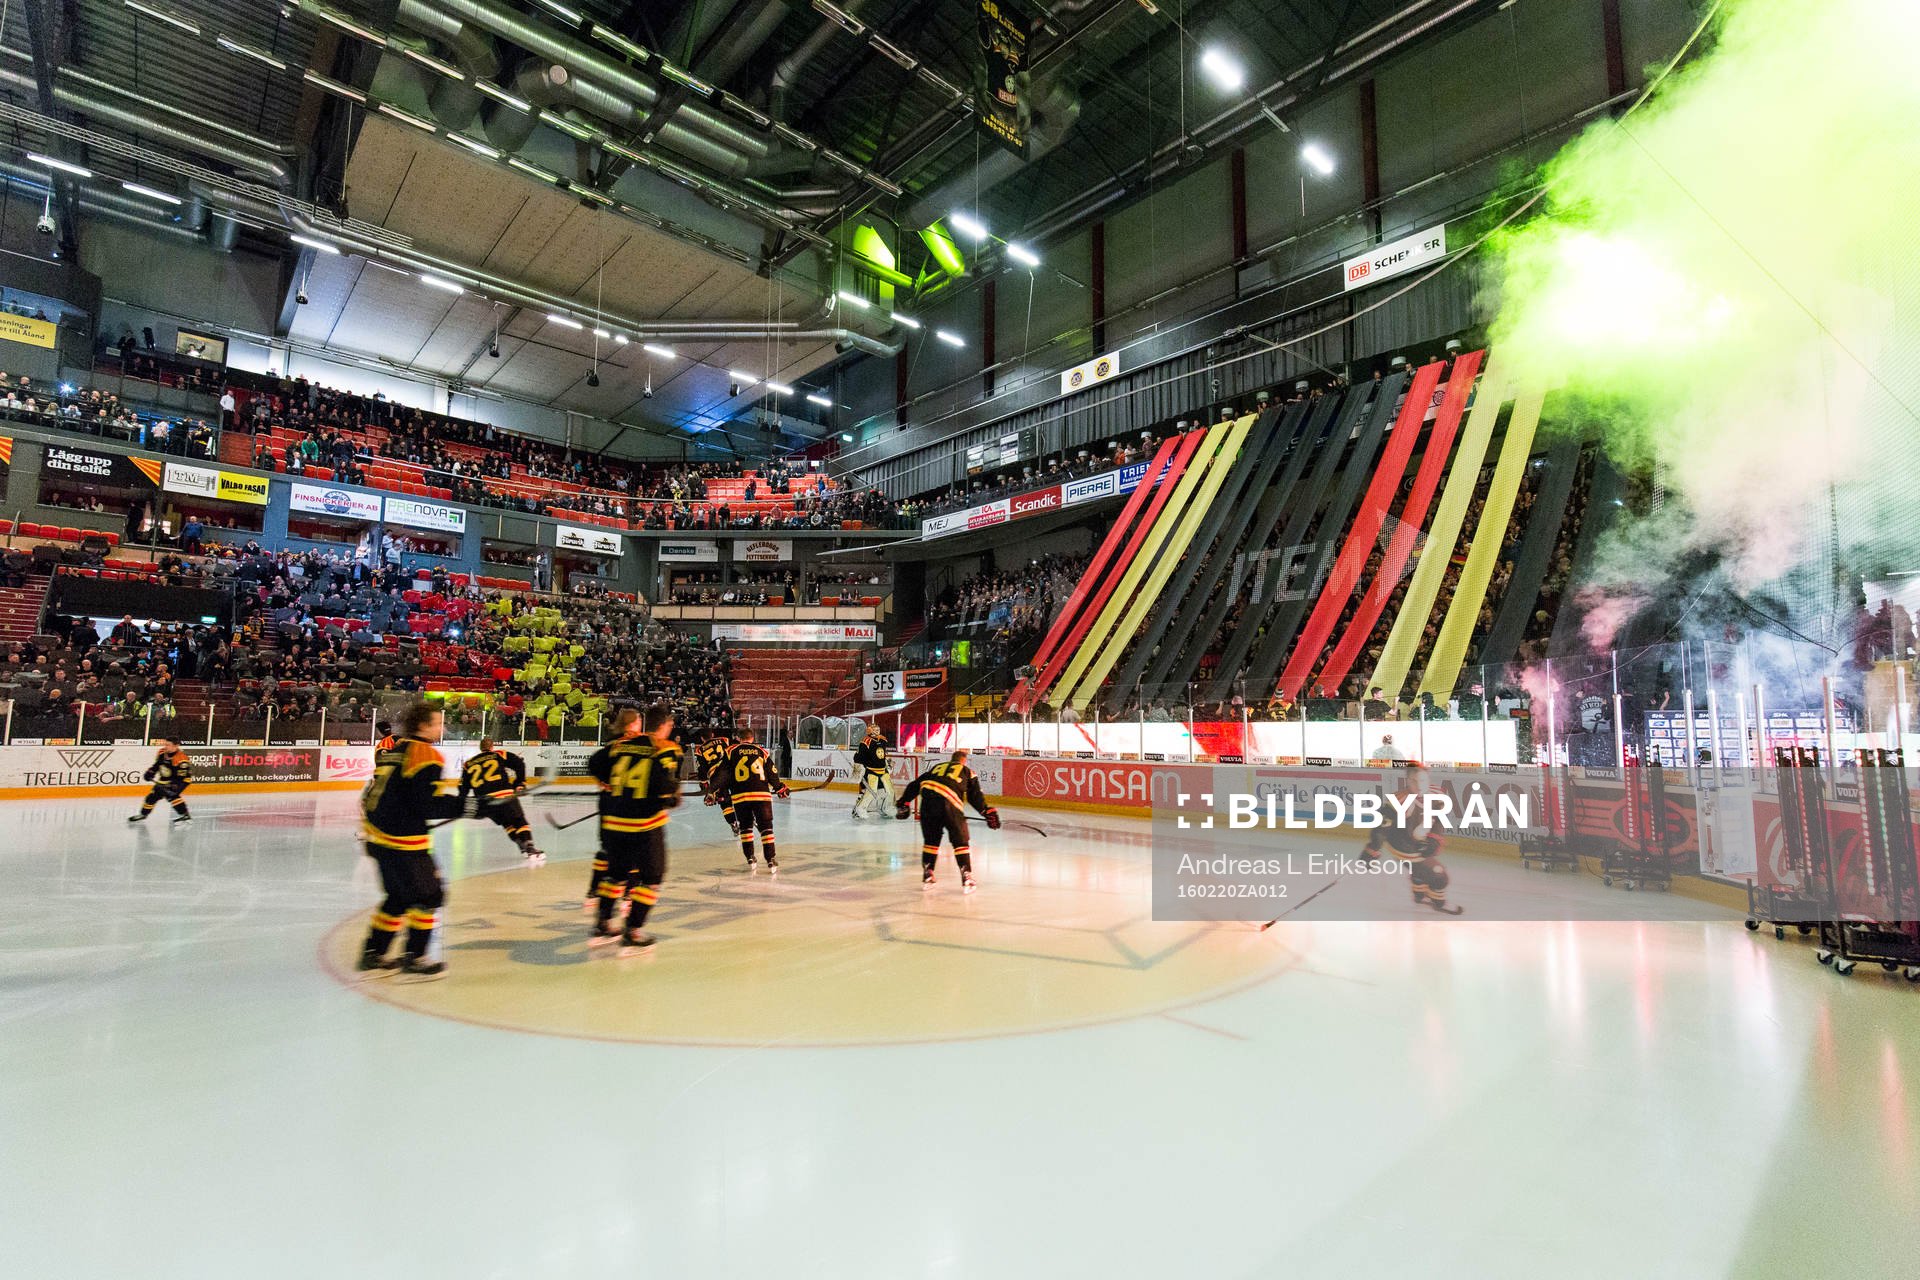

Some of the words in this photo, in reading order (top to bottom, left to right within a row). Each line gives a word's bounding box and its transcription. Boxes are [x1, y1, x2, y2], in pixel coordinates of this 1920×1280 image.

[1351, 265, 1367, 278] DB
[22, 329, 46, 340] Åland
[48, 448, 83, 464] Lägg
[84, 455, 112, 467] upp
[47, 459, 71, 471] din
[73, 464, 111, 476] selfie
[244, 484, 266, 496] FASAD
[1069, 480, 1112, 499] PIERRE
[294, 493, 364, 510] FINSNICKERIER
[366, 504, 379, 512] AB
[981, 505, 993, 514] ICA
[1015, 493, 1057, 512] Scandic
[928, 518, 949, 533] MEJ
[873, 673, 895, 691] SFS
[222, 753, 312, 769] nobosport
[734, 755, 766, 783] 64
[1490, 764, 1517, 772] VOLVIA
[24, 771, 141, 787] TRELLEBORG
[190, 775, 216, 783] ävles
[219, 774, 254, 782] största
[256, 773, 312, 782] hockeybutik
[467, 759, 502, 788] 22
[796, 766, 849, 779] NORRPOTEN
[1586, 770, 1616, 778] VOLVIA
[1256, 782, 1309, 803] Gävle
